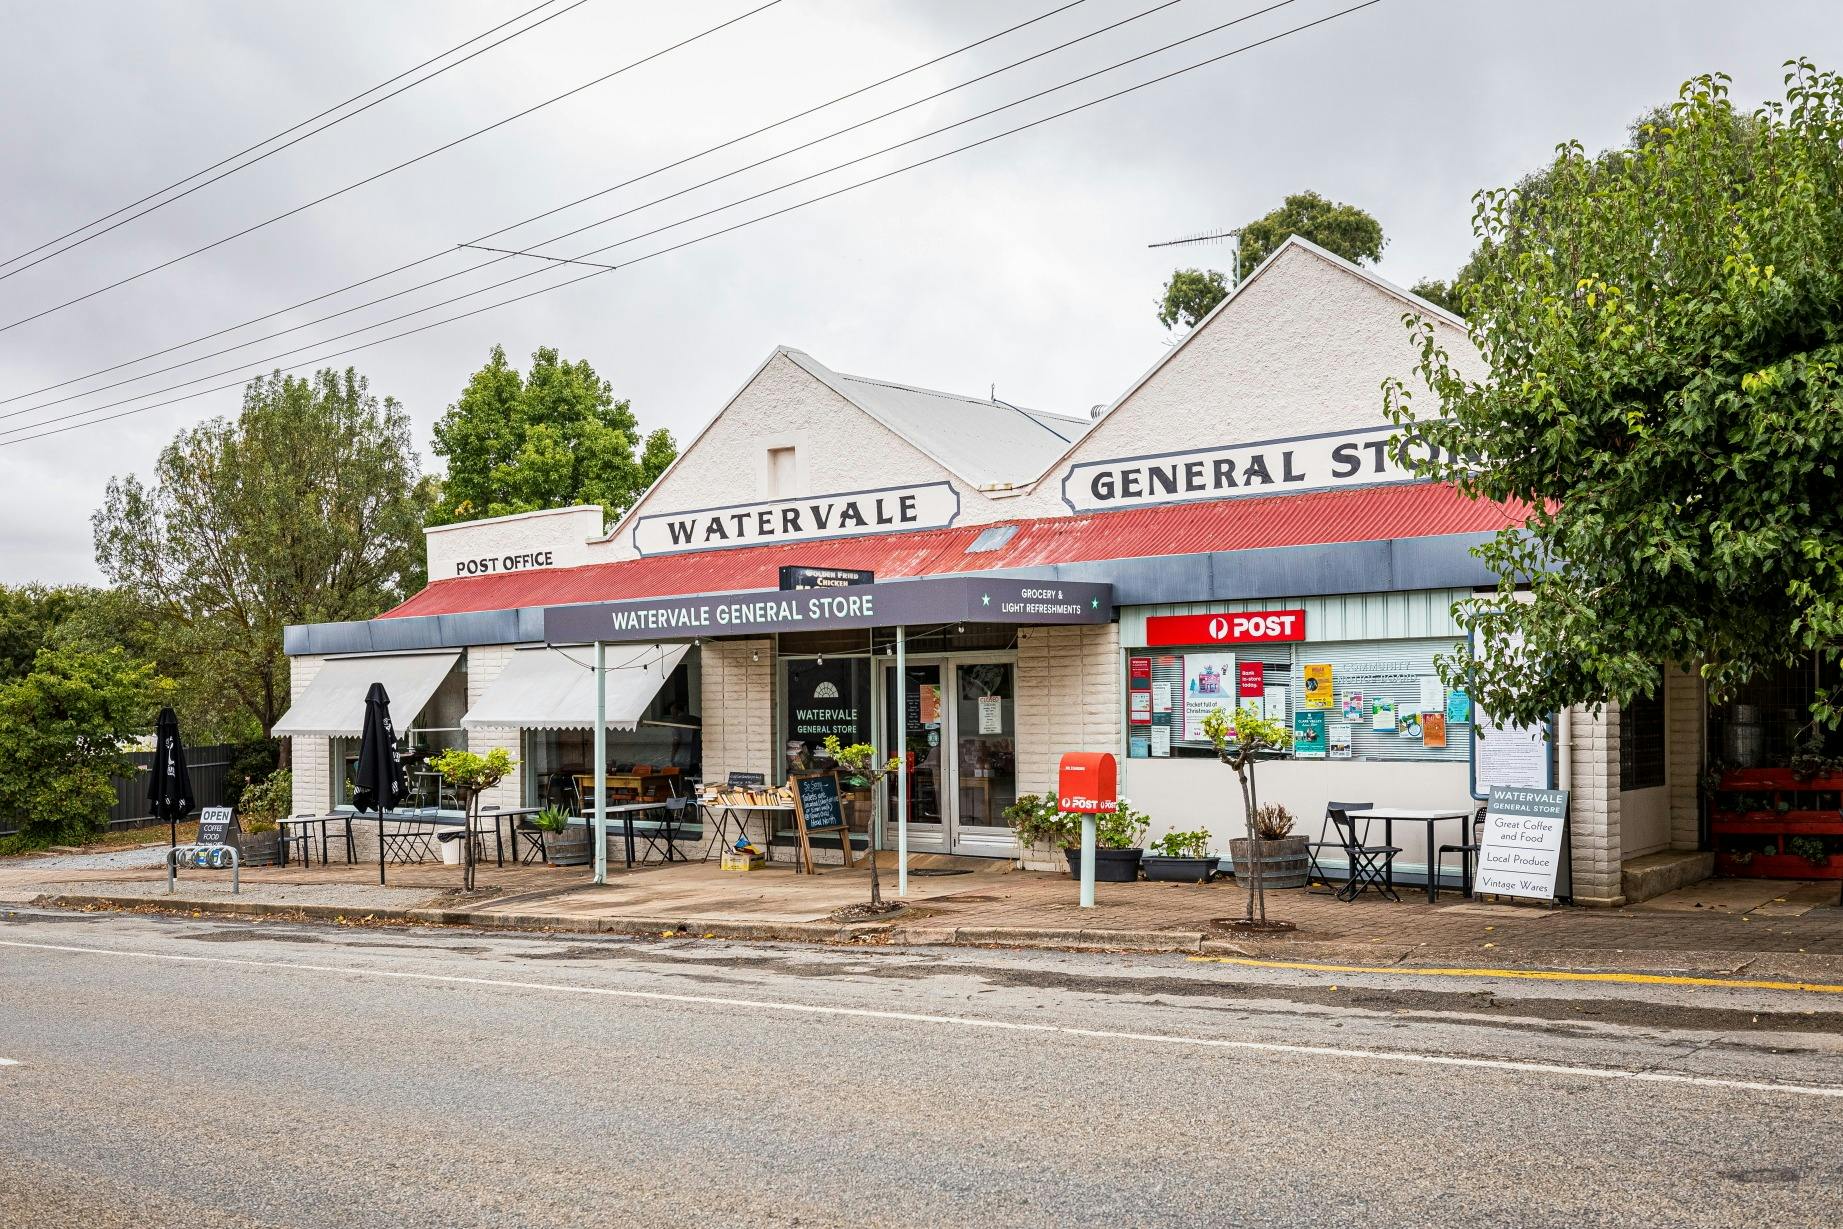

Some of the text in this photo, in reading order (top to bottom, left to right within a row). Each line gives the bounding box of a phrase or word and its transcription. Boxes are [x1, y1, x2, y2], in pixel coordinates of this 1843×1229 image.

[1090, 450, 1306, 501] GENERAL
[667, 494, 918, 545] WATERVALE
[456, 551, 554, 576] POST OFFICE
[1021, 588, 1064, 599] GROCERY &
[612, 595, 874, 631] WATERVALE GENERAL STORE
[1001, 603, 1081, 614] LIGHT REFRESHMENTS
[1233, 615, 1296, 637] POST
[796, 709, 858, 720] WATERVALE
[797, 725, 857, 733] GENERAL STORE
[1494, 790, 1564, 804] WATERVALE
[1072, 799, 1098, 809] POST
[1493, 802, 1561, 814] GENERAL STORE
[203, 811, 230, 821] OPEN
[203, 824, 223, 832] COFFEE
[1494, 818, 1553, 832] Great Coffee
[203, 833, 220, 841] FOOD
[1500, 832, 1544, 843] and Food
[1487, 852, 1550, 867] Local Produce
[1482, 876, 1548, 892] Vintage Wares
